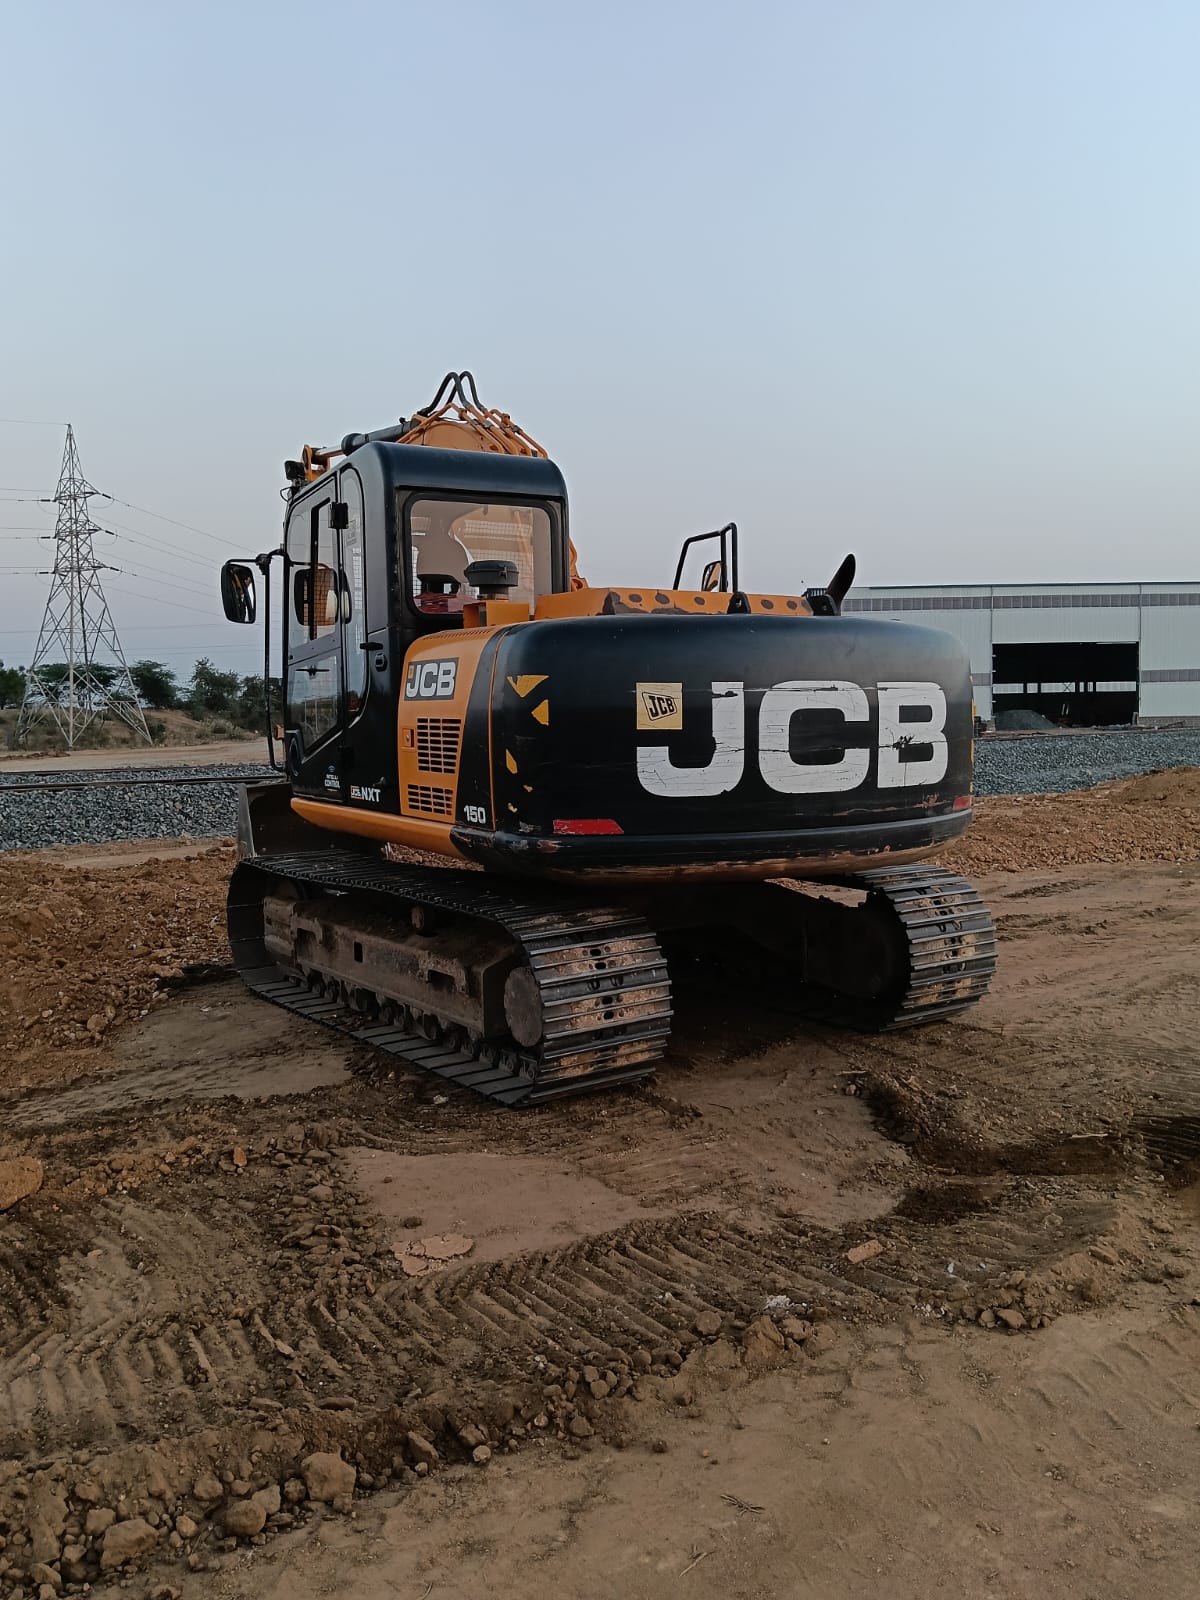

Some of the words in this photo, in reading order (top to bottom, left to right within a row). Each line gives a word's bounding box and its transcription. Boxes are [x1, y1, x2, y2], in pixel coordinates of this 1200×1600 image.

[406, 661, 456, 697] JCB
[648, 695, 675, 718] JCB
[636, 680, 949, 797] JCB
[361, 786, 381, 802] NXT
[463, 805, 486, 824] 150
